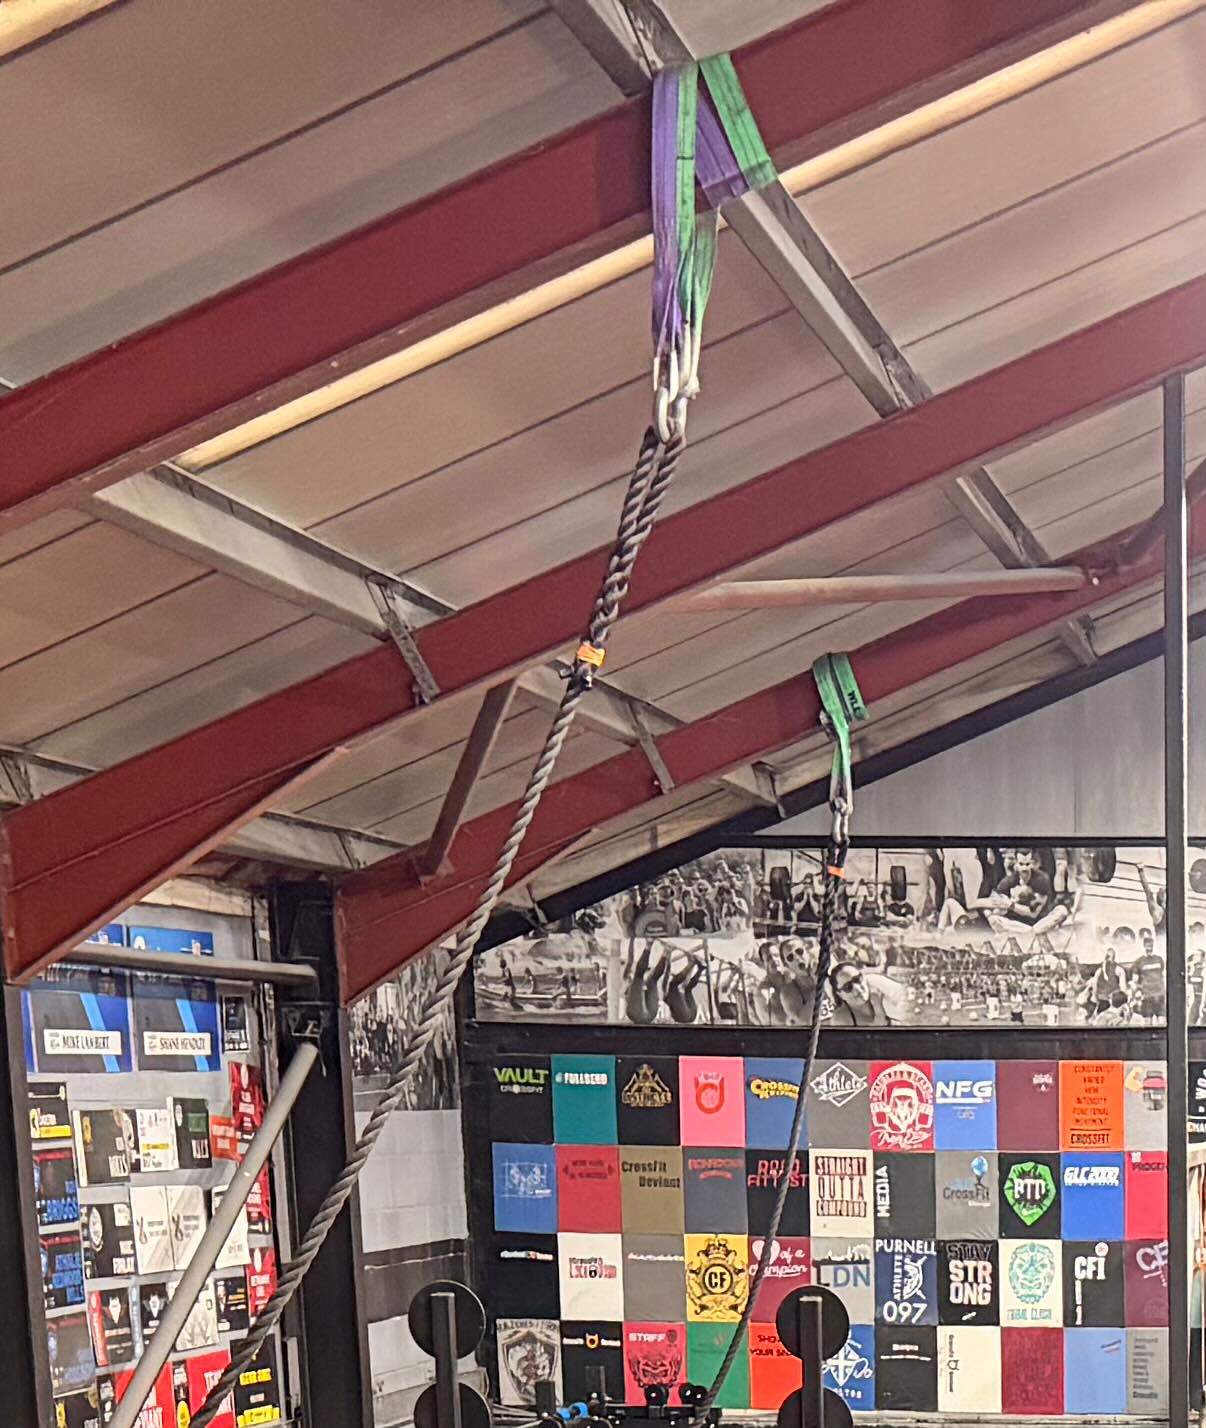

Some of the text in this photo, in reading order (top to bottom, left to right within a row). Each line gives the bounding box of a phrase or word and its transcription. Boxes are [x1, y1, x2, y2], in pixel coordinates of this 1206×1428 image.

[494, 1067, 548, 1084] VAULT
[936, 1081, 992, 1098] NFG
[621, 1160, 667, 1173] CrossFit
[816, 1157, 864, 1175] STRAIGHT
[748, 1174, 808, 1188] FITTST
[817, 1176, 865, 1199] OUTTA
[875, 1239, 936, 1255] PURNELL
[708, 1272, 728, 1288] CF
[948, 1260, 993, 1284] STR
[949, 1283, 992, 1305] ONG
[883, 1301, 927, 1324] 097
